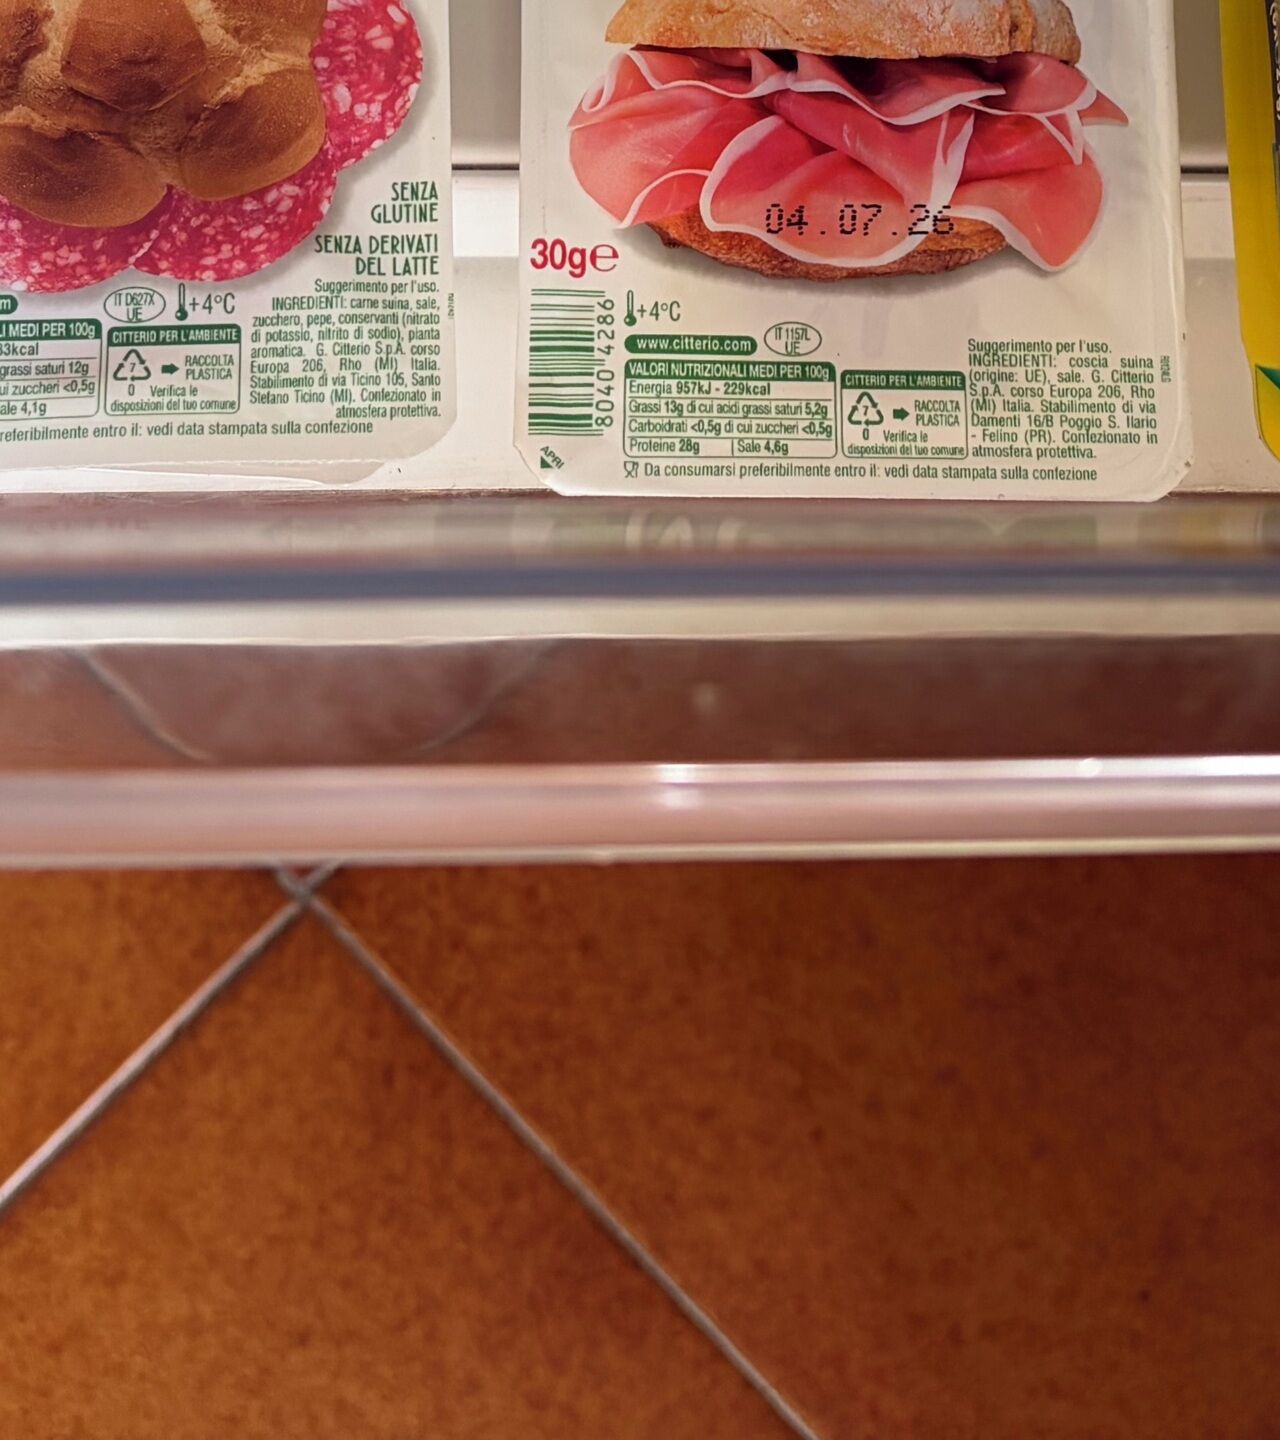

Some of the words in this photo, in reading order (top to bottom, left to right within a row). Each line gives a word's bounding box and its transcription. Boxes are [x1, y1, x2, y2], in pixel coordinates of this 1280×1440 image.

[391, 181, 439, 202] SENZA
[370, 203, 439, 224] GLUTINE
[764, 202, 956, 237] 04.07.26
[314, 234, 363, 255] SENZA
[368, 233, 439, 255] DERIVATI
[355, 257, 387, 277] DEL
[392, 256, 440, 276] LATTE
[529, 237, 587, 279] 30g
[589, 244, 620, 272] e
[188, 292, 237, 315] +4°C
[636, 300, 682, 323] +4°C
[8, 322, 40, 338] MEDI
[41, 321, 67, 337] PER
[68, 321, 97, 340] 100g
[111, 330, 158, 345] CITTERIO
[158, 330, 180, 343] PER
[180, 327, 239, 343] L'AMBIENTE
[596, 297, 617, 357] 4286
[636, 335, 753, 354] www.citterio.com
[183, 353, 235, 368] RACCOLTA
[185, 367, 234, 381] PLASTICA
[628, 362, 669, 377] VALORI
[670, 362, 748, 379] NUTRIZIONALI
[749, 364, 778, 379] MEDI
[779, 364, 803, 379] PER
[804, 364, 830, 382] 100g
[594, 368, 617, 429] 8040
[628, 379, 673, 397] Energia
[675, 380, 712, 397] 957kJ
[722, 381, 772, 397] 229kcal
[20, 401, 48, 419] 4,1g
[92, 423, 128, 439] entro
[130, 422, 144, 438] il:
[146, 421, 174, 437] vedi
[176, 421, 205, 436] data
[207, 421, 269, 439] stampata
[270, 420, 302, 436] sulla
[304, 419, 374, 436] confezione
